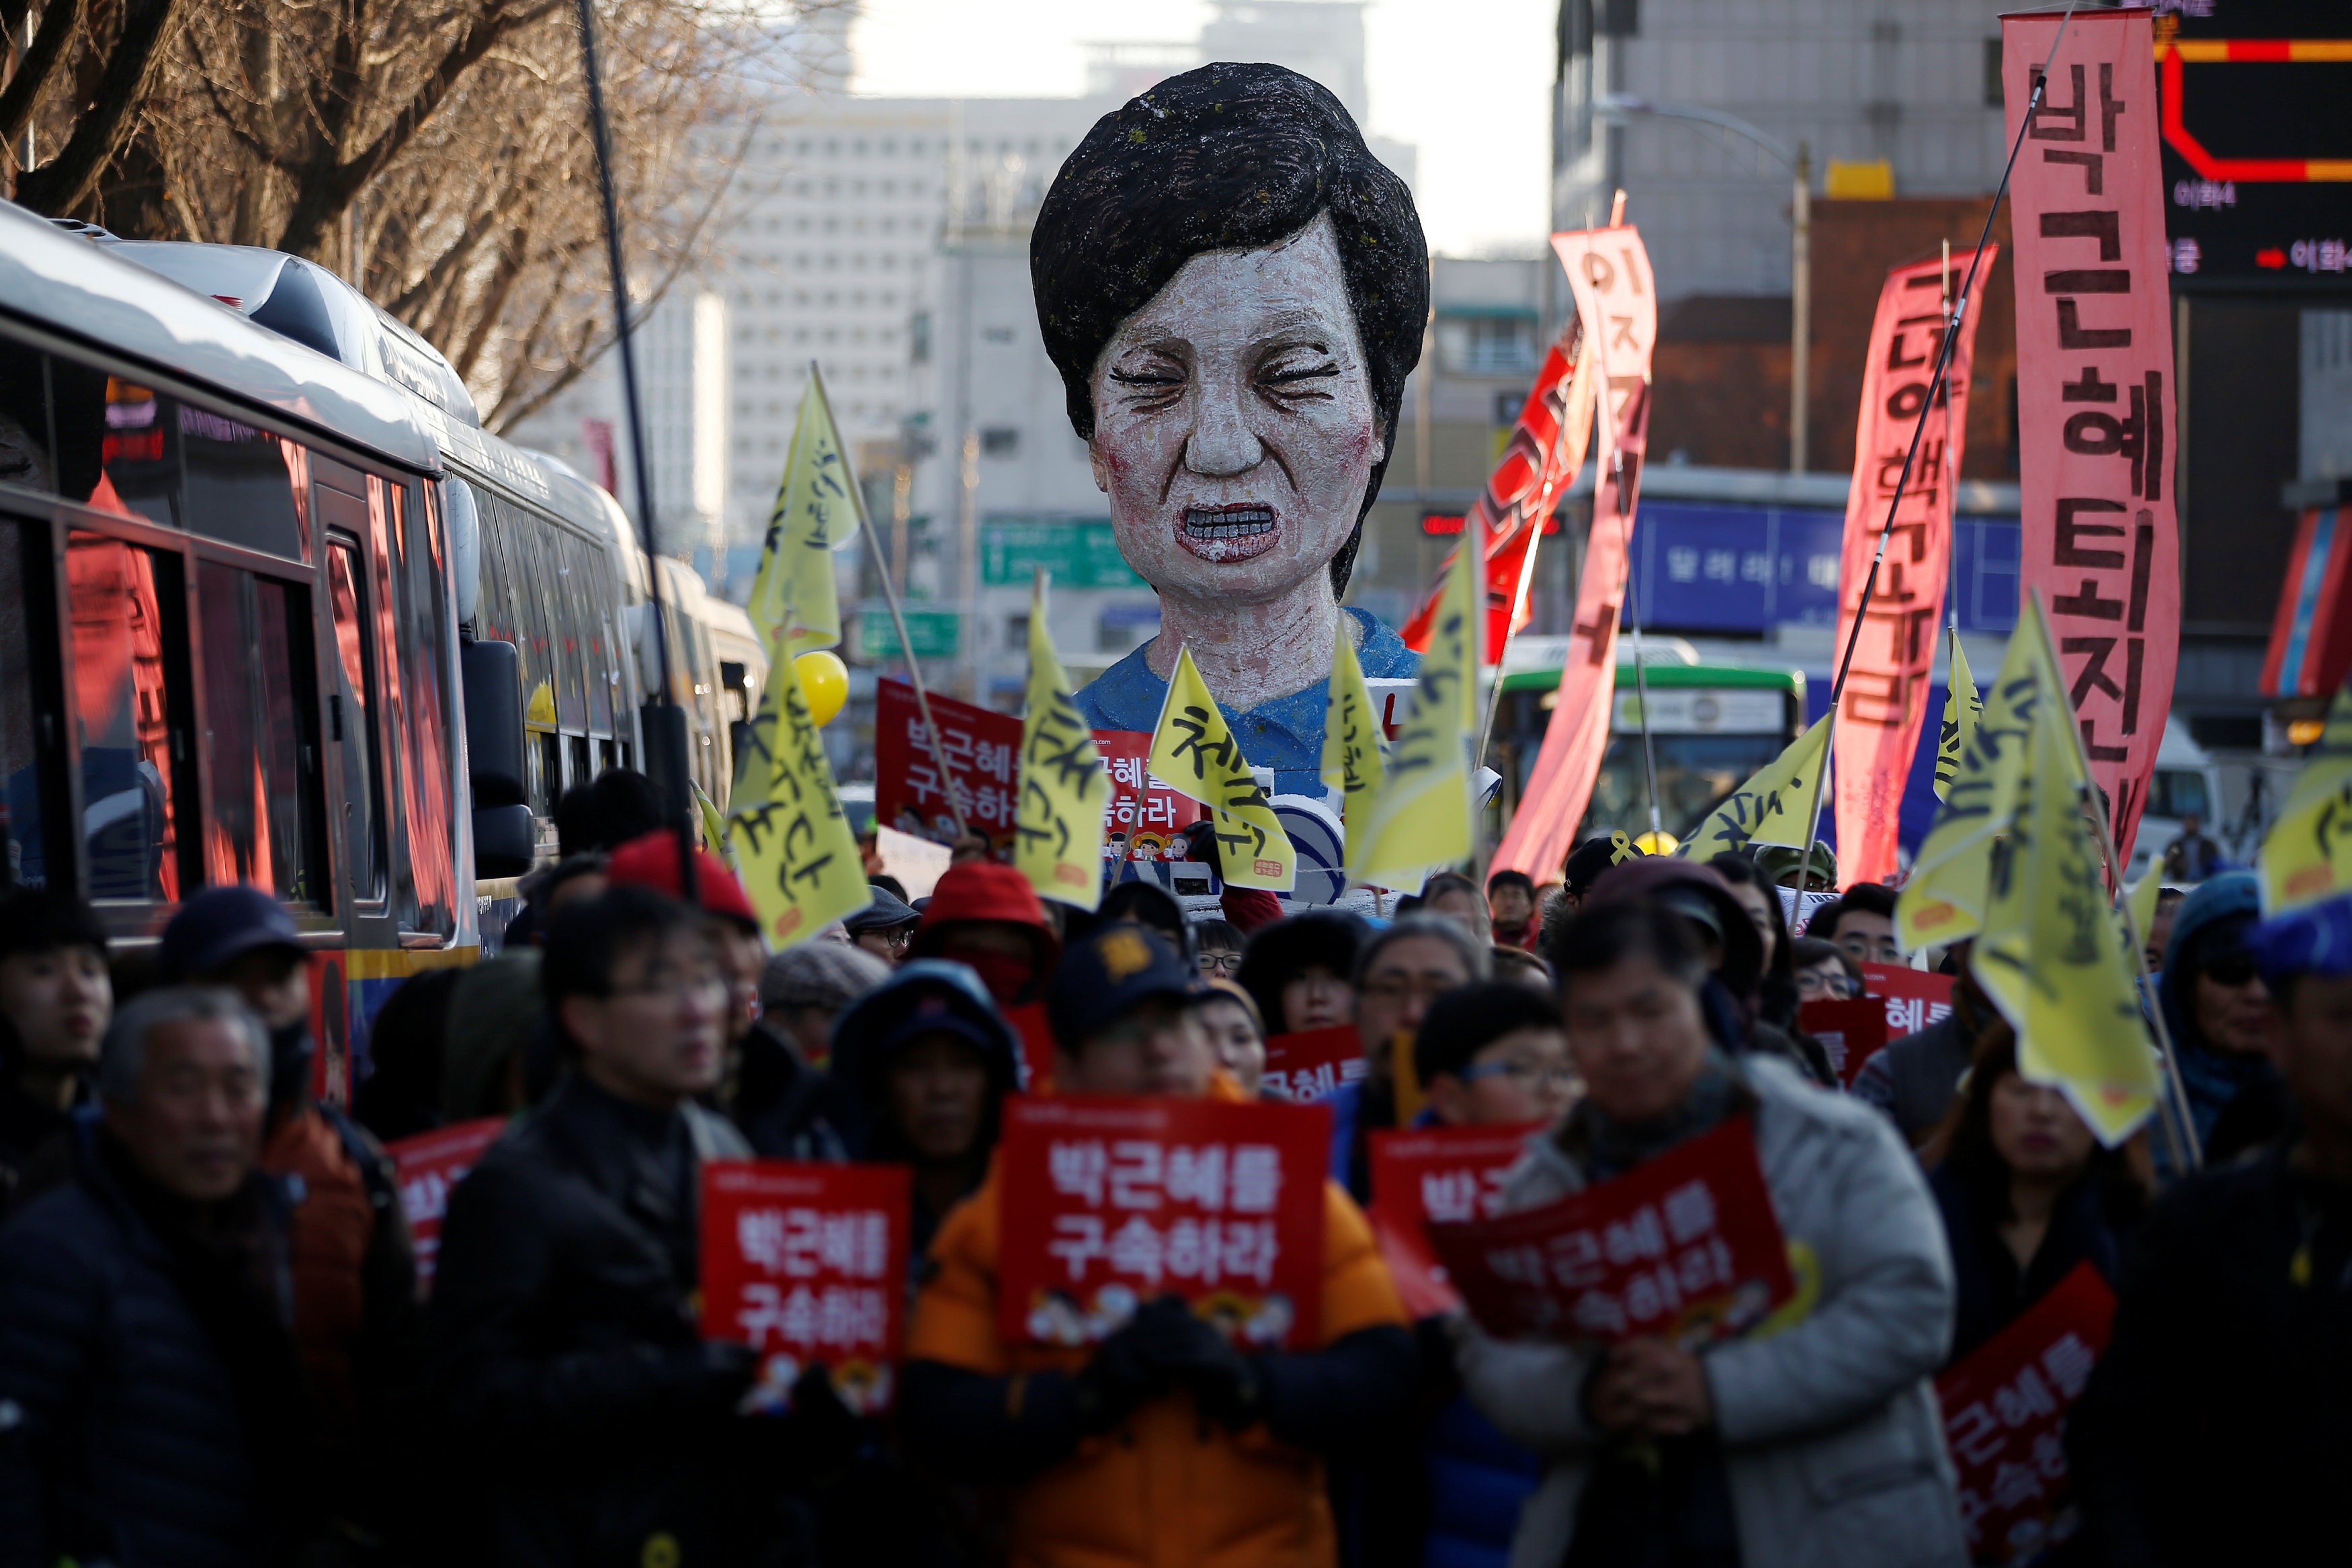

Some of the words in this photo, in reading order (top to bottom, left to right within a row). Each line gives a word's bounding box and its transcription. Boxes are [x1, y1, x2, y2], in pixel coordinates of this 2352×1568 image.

[1048, 1139, 1281, 1212] 박근혜를
[737, 1206, 888, 1280] 박근혜를
[1048, 1213, 1279, 1286] 구속하라
